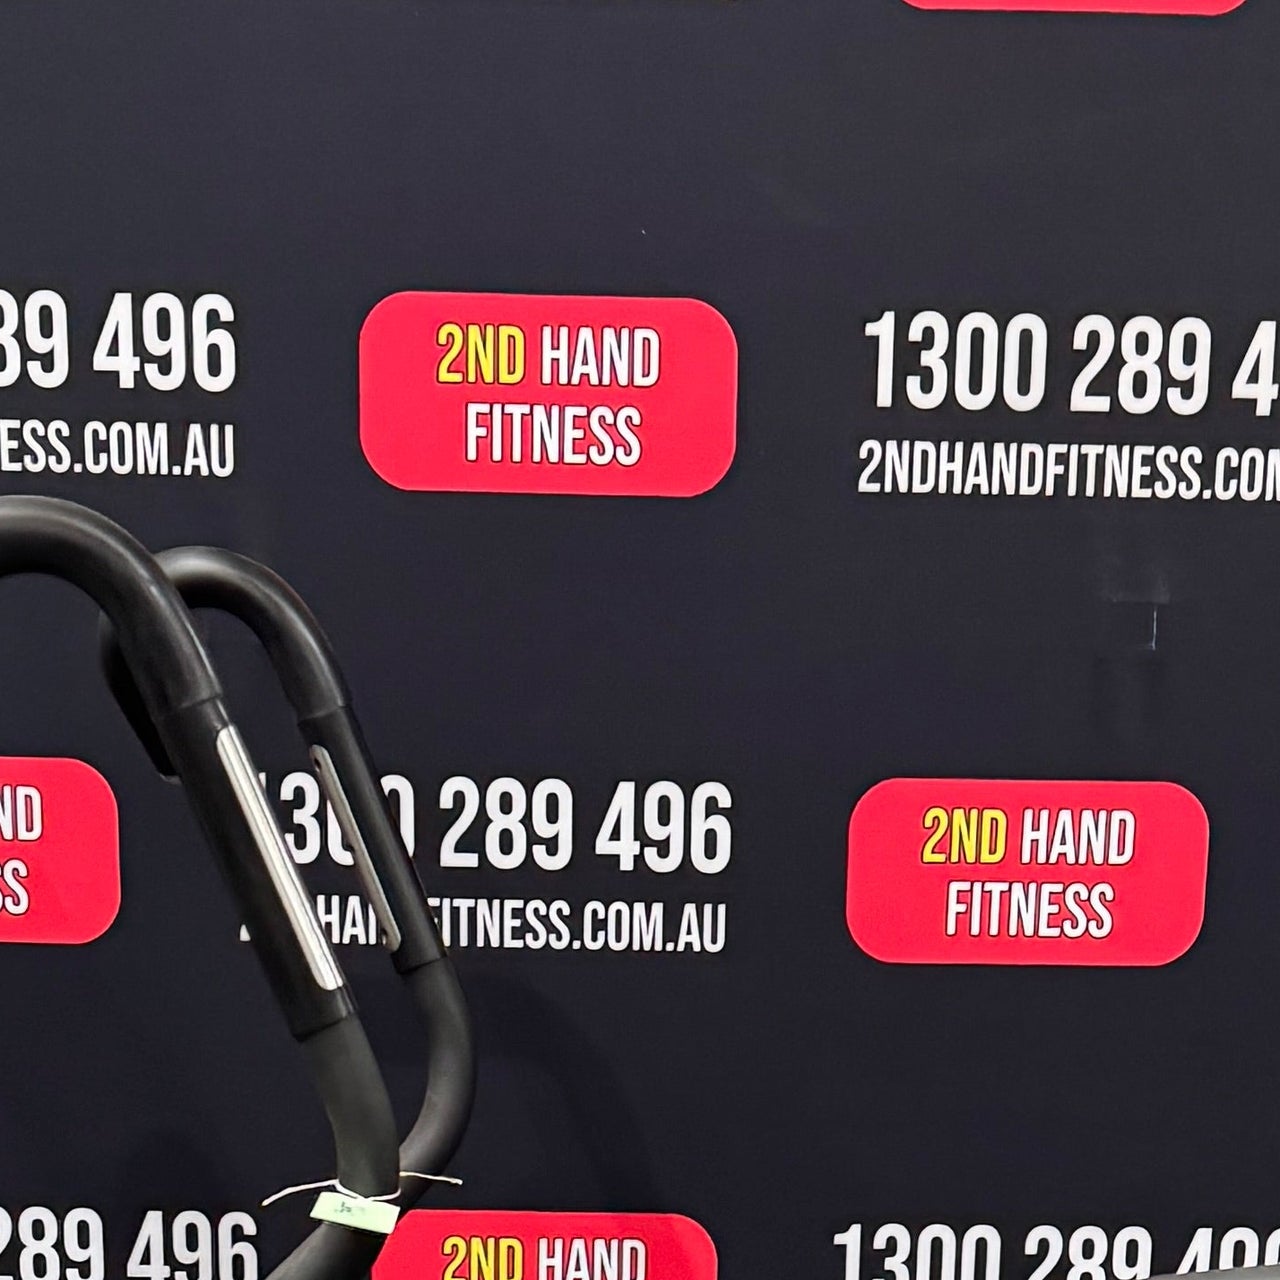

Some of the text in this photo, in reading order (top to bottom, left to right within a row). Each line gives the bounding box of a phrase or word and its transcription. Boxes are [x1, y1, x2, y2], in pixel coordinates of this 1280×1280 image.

[92, 292, 236, 393] 496
[438, 323, 660, 387] 2ND HAND
[864, 310, 1048, 412] 1300
[1069, 314, 1212, 416] 289
[467, 402, 641, 466] FITNESS
[439, 775, 573, 871] 289
[595, 780, 732, 874] 496
[922, 807, 1135, 865] 2ND HAND
[946, 881, 1114, 938] FITNESS
